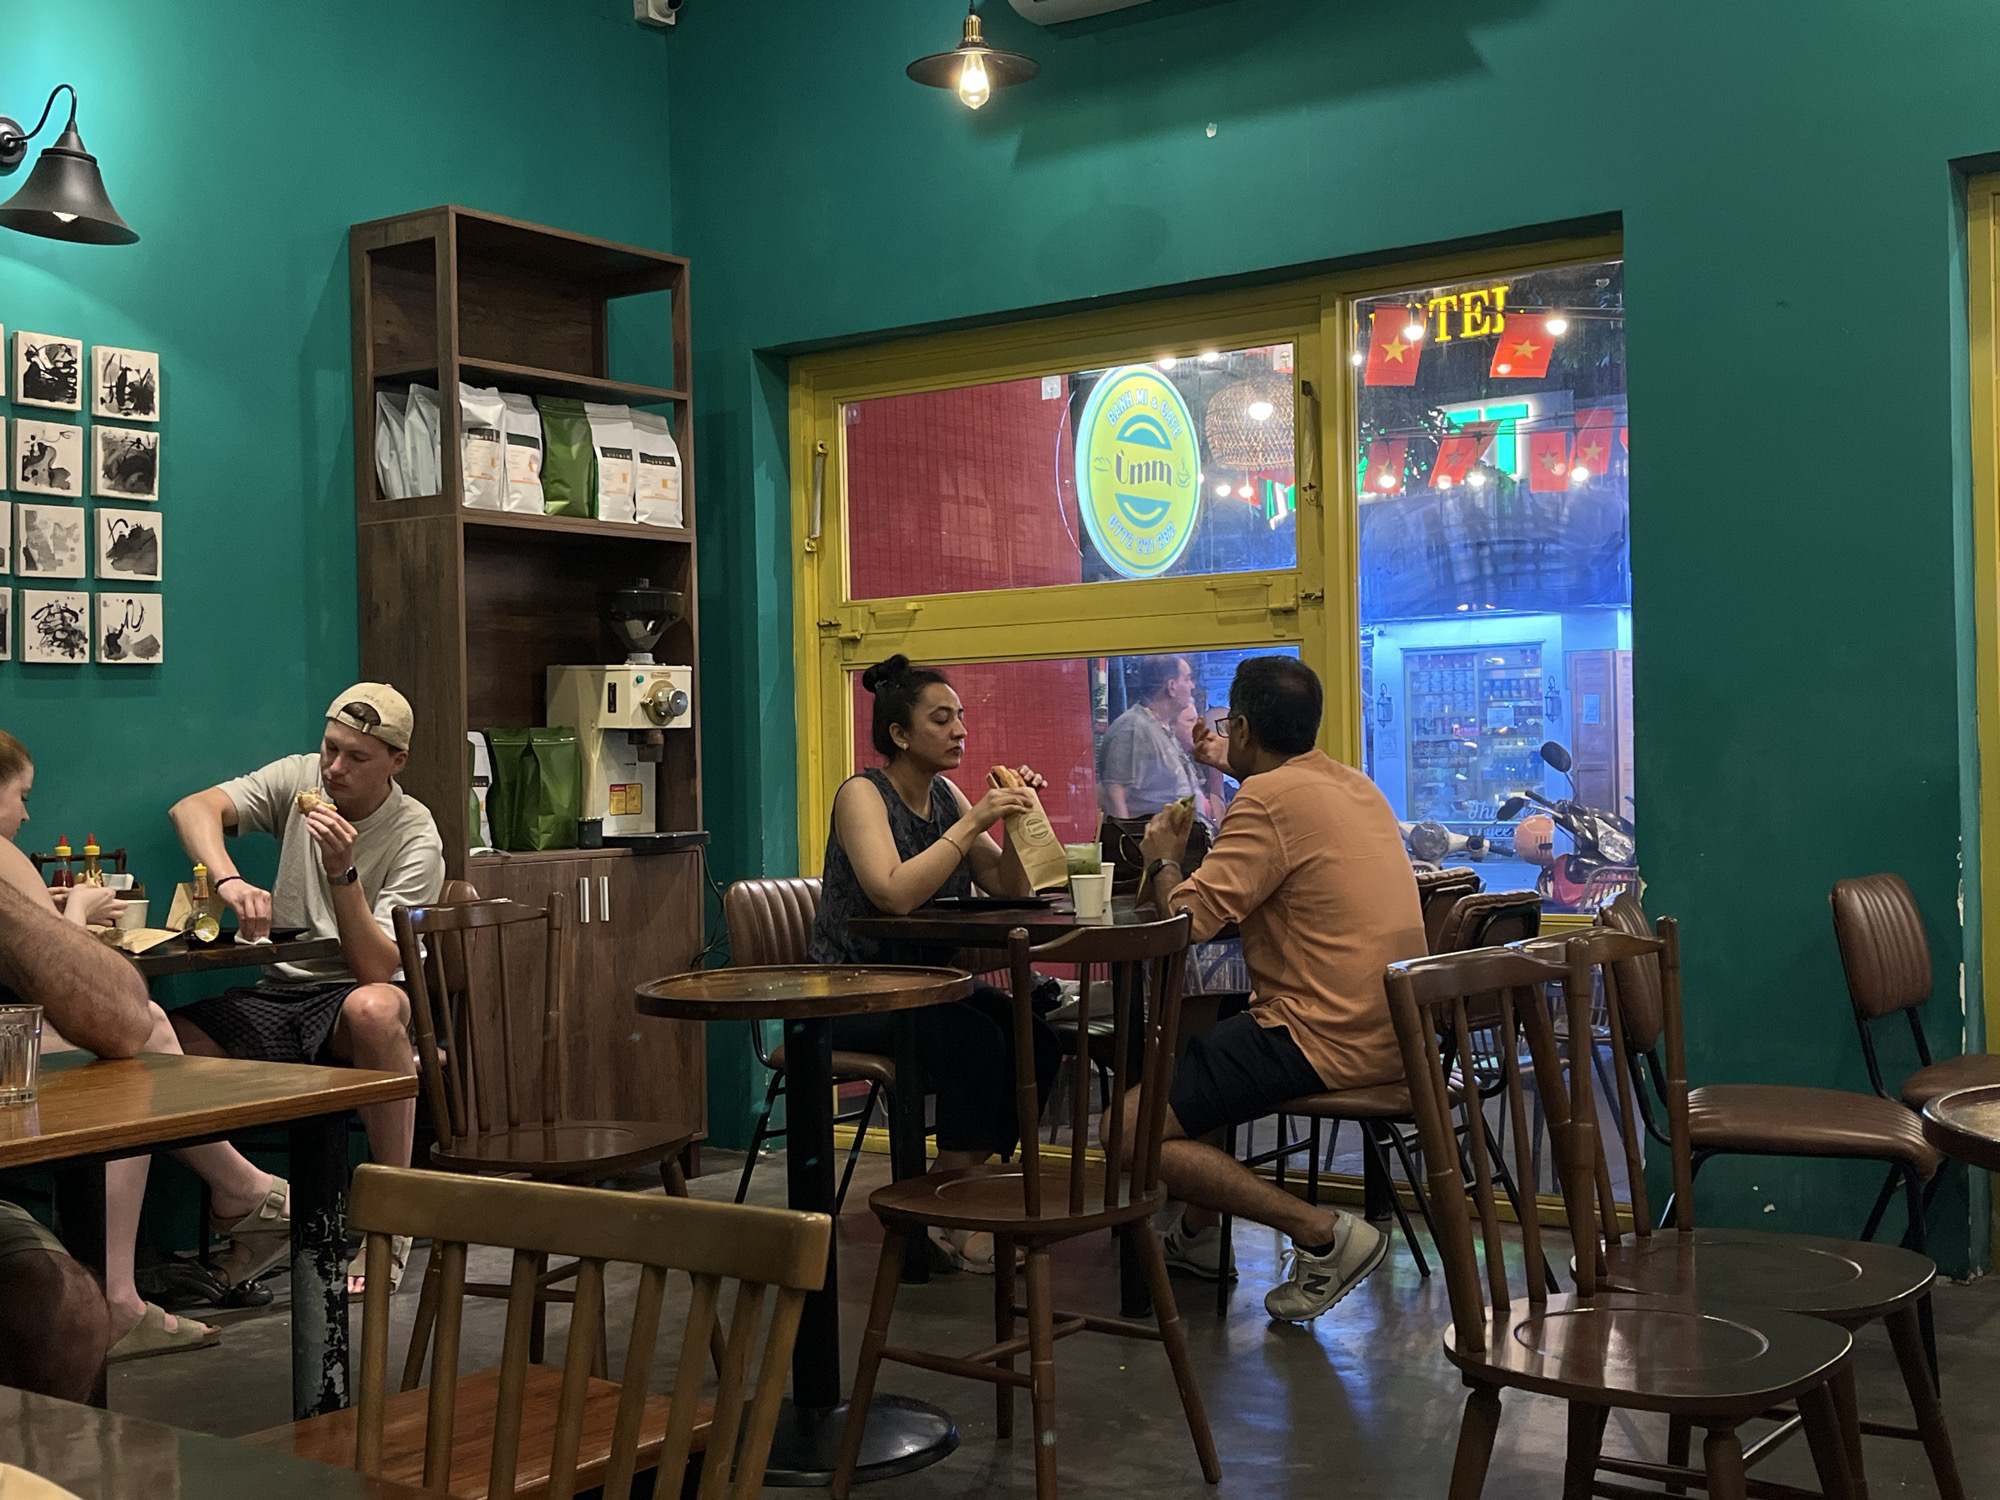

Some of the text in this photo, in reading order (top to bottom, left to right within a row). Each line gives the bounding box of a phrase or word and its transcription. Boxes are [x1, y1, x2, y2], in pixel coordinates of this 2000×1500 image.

[1107, 389, 1182, 438] BANH MI & CAFE
[1107, 513, 1177, 554] 0772 221 282
[1302, 1273, 1331, 1295] N
